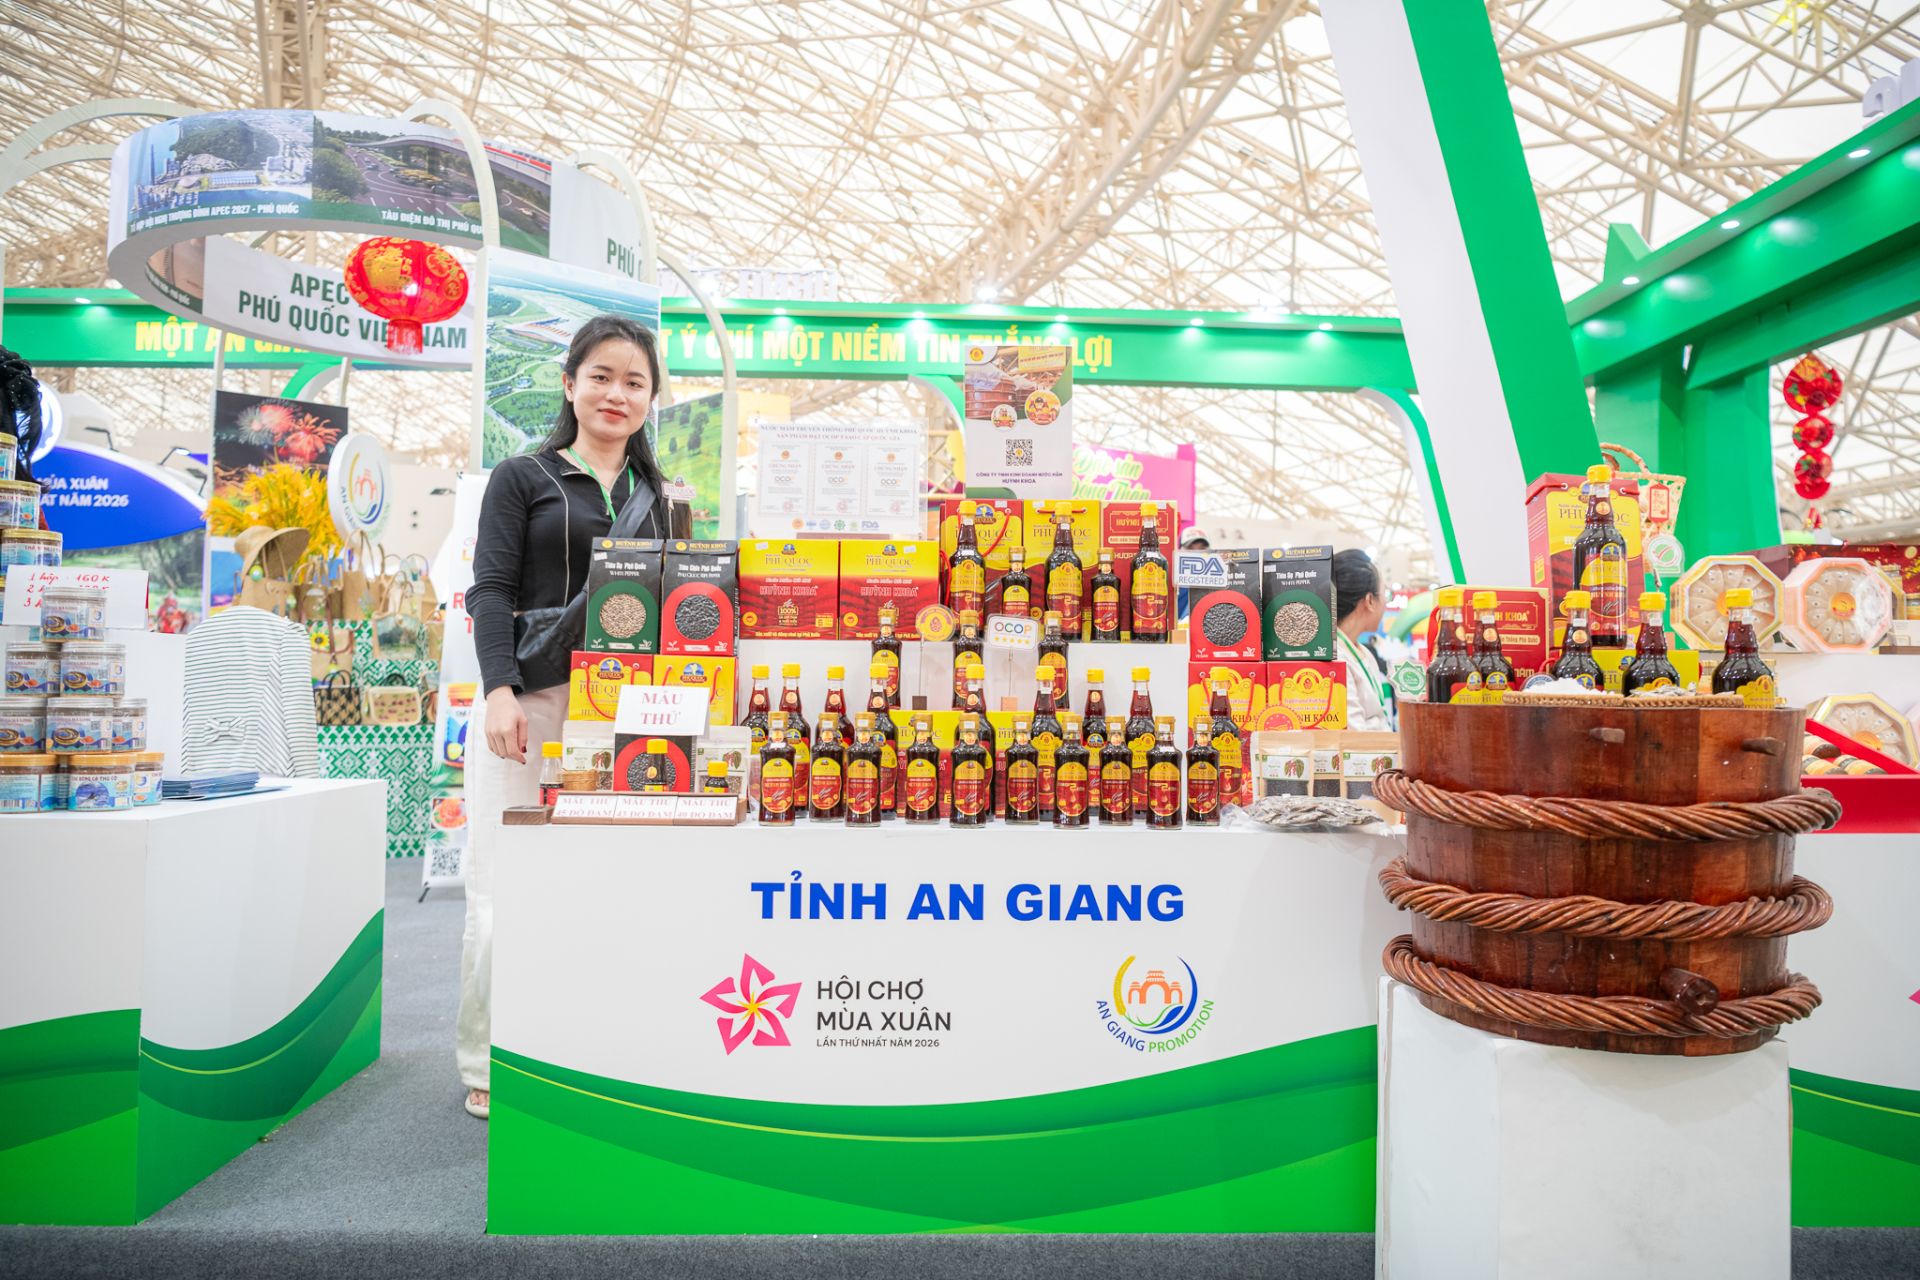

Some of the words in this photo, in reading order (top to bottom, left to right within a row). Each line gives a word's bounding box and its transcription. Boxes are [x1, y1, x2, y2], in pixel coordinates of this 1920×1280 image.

[210, 205, 230, 216] APEC
[231, 204, 250, 215] 2027
[257, 203, 274, 214] PHÚ
[276, 201, 299, 214] QUỐC
[381, 210, 399, 222] TÀU
[400, 211, 422, 226] ĐIỆN
[422, 212, 435, 226] ĐÔ
[437, 217, 450, 230] THỊ
[452, 219, 469, 232] PHÚ
[607, 238, 635, 278] PHÚ
[290, 272, 349, 305] APEC
[238, 290, 281, 323] PHÚ
[288, 305, 350, 337] QUỐC
[135, 316, 198, 358] MỘT
[681, 322, 698, 358] Ý
[763, 324, 825, 366] MỘT
[832, 322, 906, 363] NIỀM
[914, 332, 961, 365] TIN
[1072, 335, 1112, 373] LỢI
[69, 475, 109, 490] XUÂN
[58, 491, 92, 507] NĂM
[93, 494, 129, 507] 2026
[1178, 556, 1225, 576] FDA
[1178, 576, 1225, 585] REGISTERED
[1505, 611, 1528, 621] KHOA
[994, 621, 1032, 635] OCOP
[750, 870, 887, 920] TỈNH
[905, 883, 985, 921] AN
[1005, 882, 1185, 922] GIANG
[817, 974, 861, 1005] HỘI
[868, 978, 924, 1005] CHỢ
[817, 1006, 873, 1031] MÙA
[880, 1006, 951, 1031] XUÂN
[1096, 1000, 1112, 1020] AN
[1107, 1020, 1146, 1051] GIANG
[1148, 999, 1215, 1053] PROMOTION
[816, 1036, 837, 1047] LẦN
[838, 1036, 860, 1047] THỨ
[861, 1035, 888, 1047] NHẤT
[889, 1036, 912, 1047] NĂM
[914, 1039, 940, 1047] 2026
